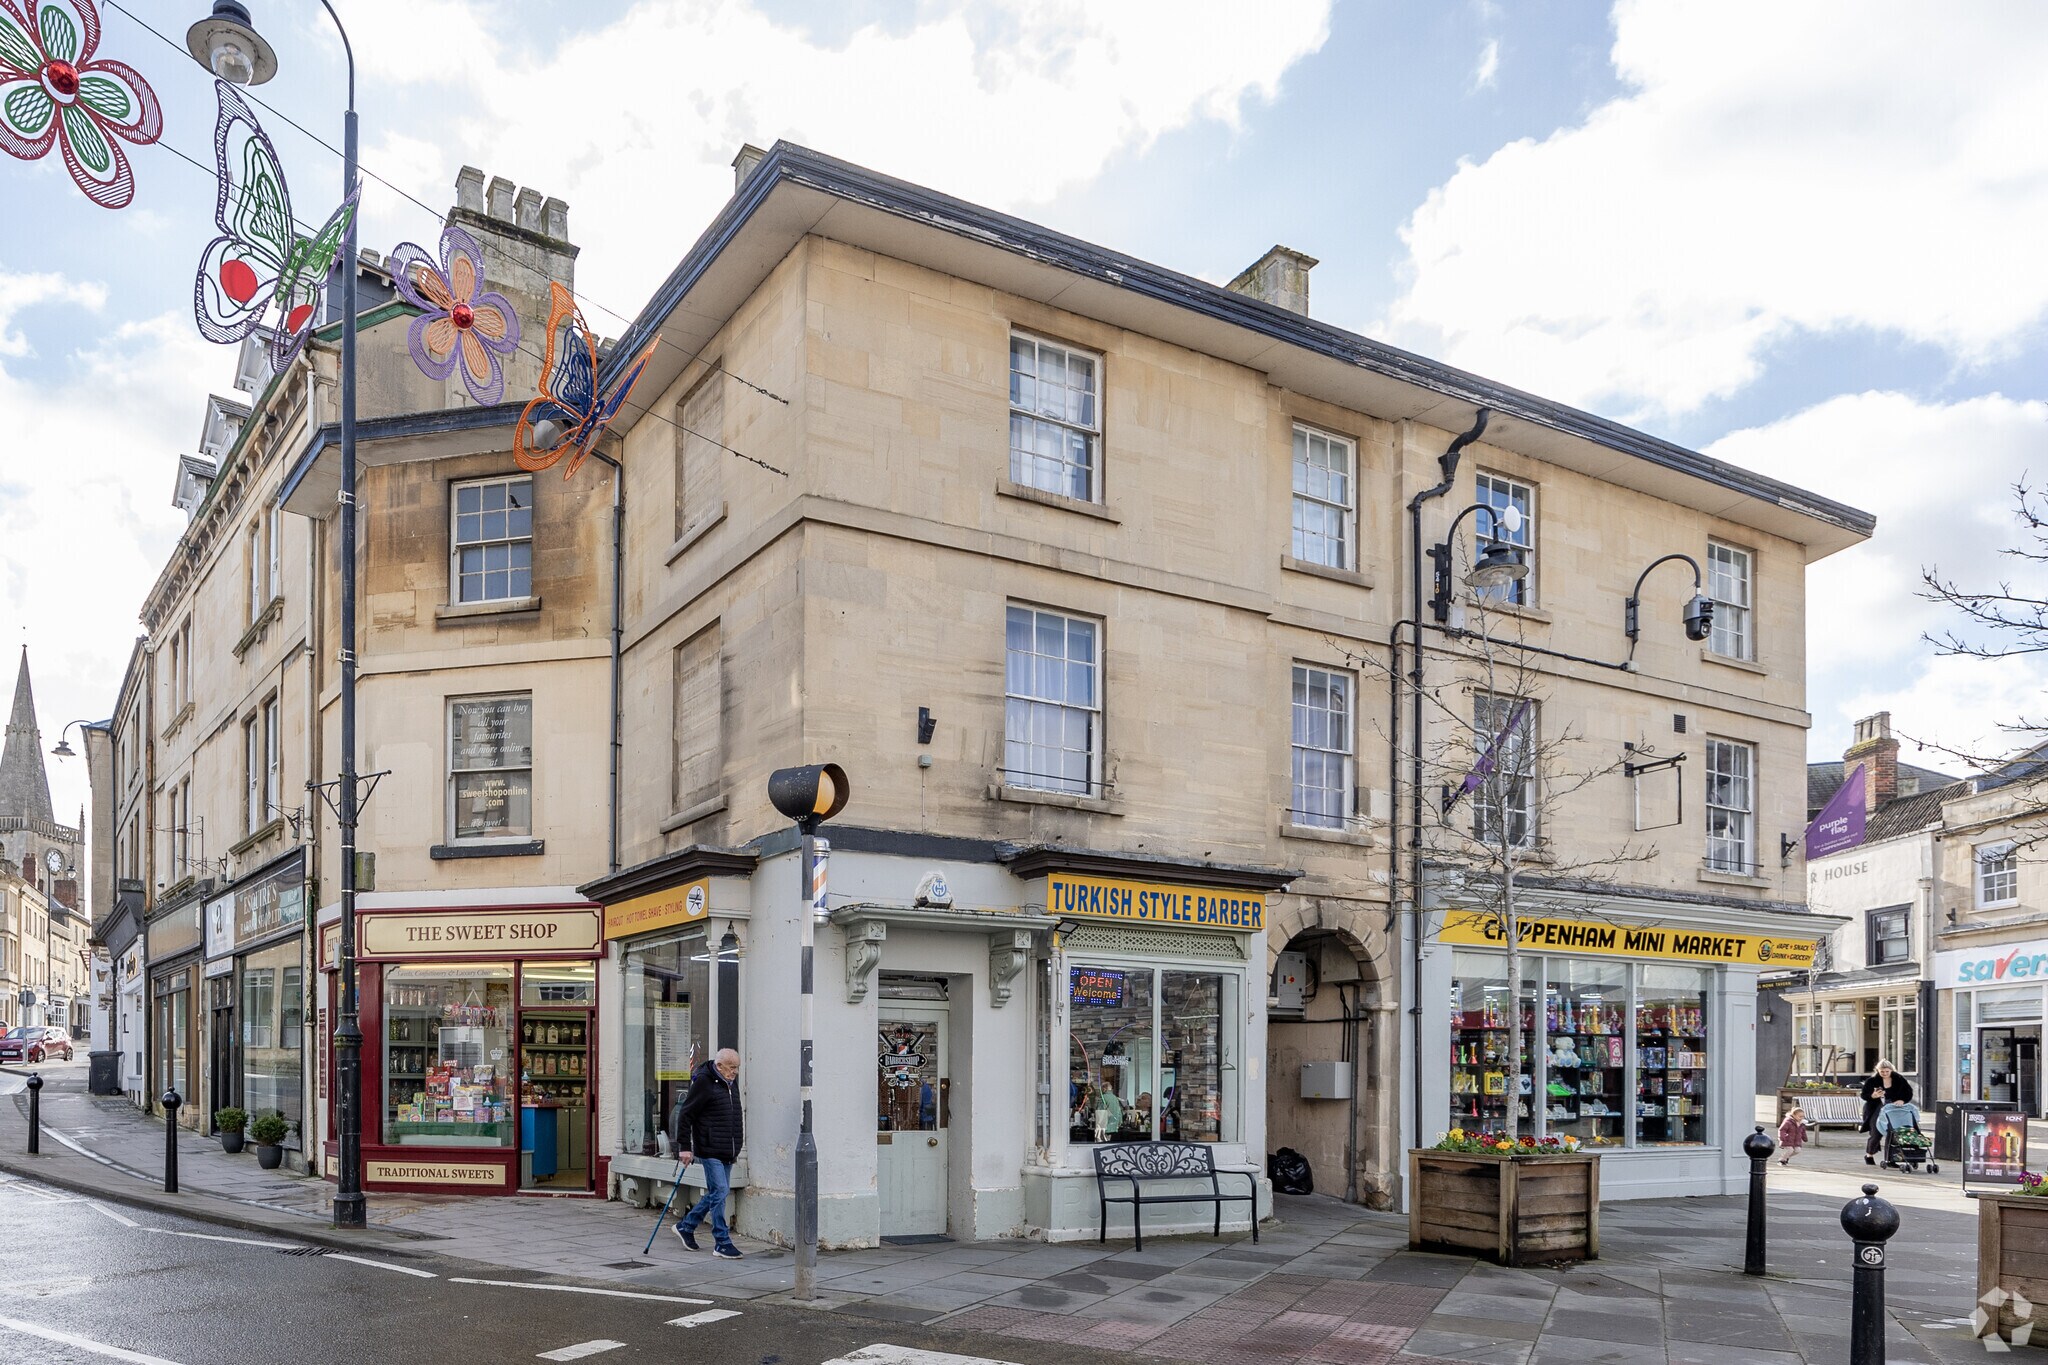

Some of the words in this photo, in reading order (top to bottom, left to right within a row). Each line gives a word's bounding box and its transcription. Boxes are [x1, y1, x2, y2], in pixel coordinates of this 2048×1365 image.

[459, 704, 480, 716] Now
[481, 705, 495, 718] you
[497, 704, 511, 714] can
[513, 703, 528, 715] buy
[477, 719, 489, 728] all
[490, 718, 509, 730] your
[473, 731, 512, 743] favourites
[460, 746, 476, 755] and
[479, 747, 498, 755] more
[500, 743, 524, 753] online
[489, 758, 498, 767] at
[484, 779, 506, 787] www.
[462, 785, 528, 799] sweetshoponline
[485, 798, 504, 807] .com
[1819, 817, 1849, 832] purple
[1830, 825, 1848, 835] flag
[1824, 861, 1869, 881] HOUSE
[243, 882, 277, 915] ESQUIRE'S
[1052, 882, 1133, 917] TURKISH
[1138, 890, 1192, 922] STYLE
[1197, 896, 1262, 927] BARBER
[648, 905, 662, 919] SHAVE
[664, 900, 683, 915] STYLING
[405, 925, 442, 942] THE
[446, 924, 506, 941] SWEET
[509, 923, 558, 940] SHOP
[1623, 930, 1666, 953] MINI
[1672, 934, 1747, 958] MARKET
[1789, 953, 1812, 961] GROCERY
[1958, 948, 2048, 982] saver
[1079, 975, 1113, 989] OPEN
[1072, 985, 1118, 1000] Welcome
[377, 1167, 450, 1179] TRADITIONAL
[451, 1168, 495, 1180] SWEETS
